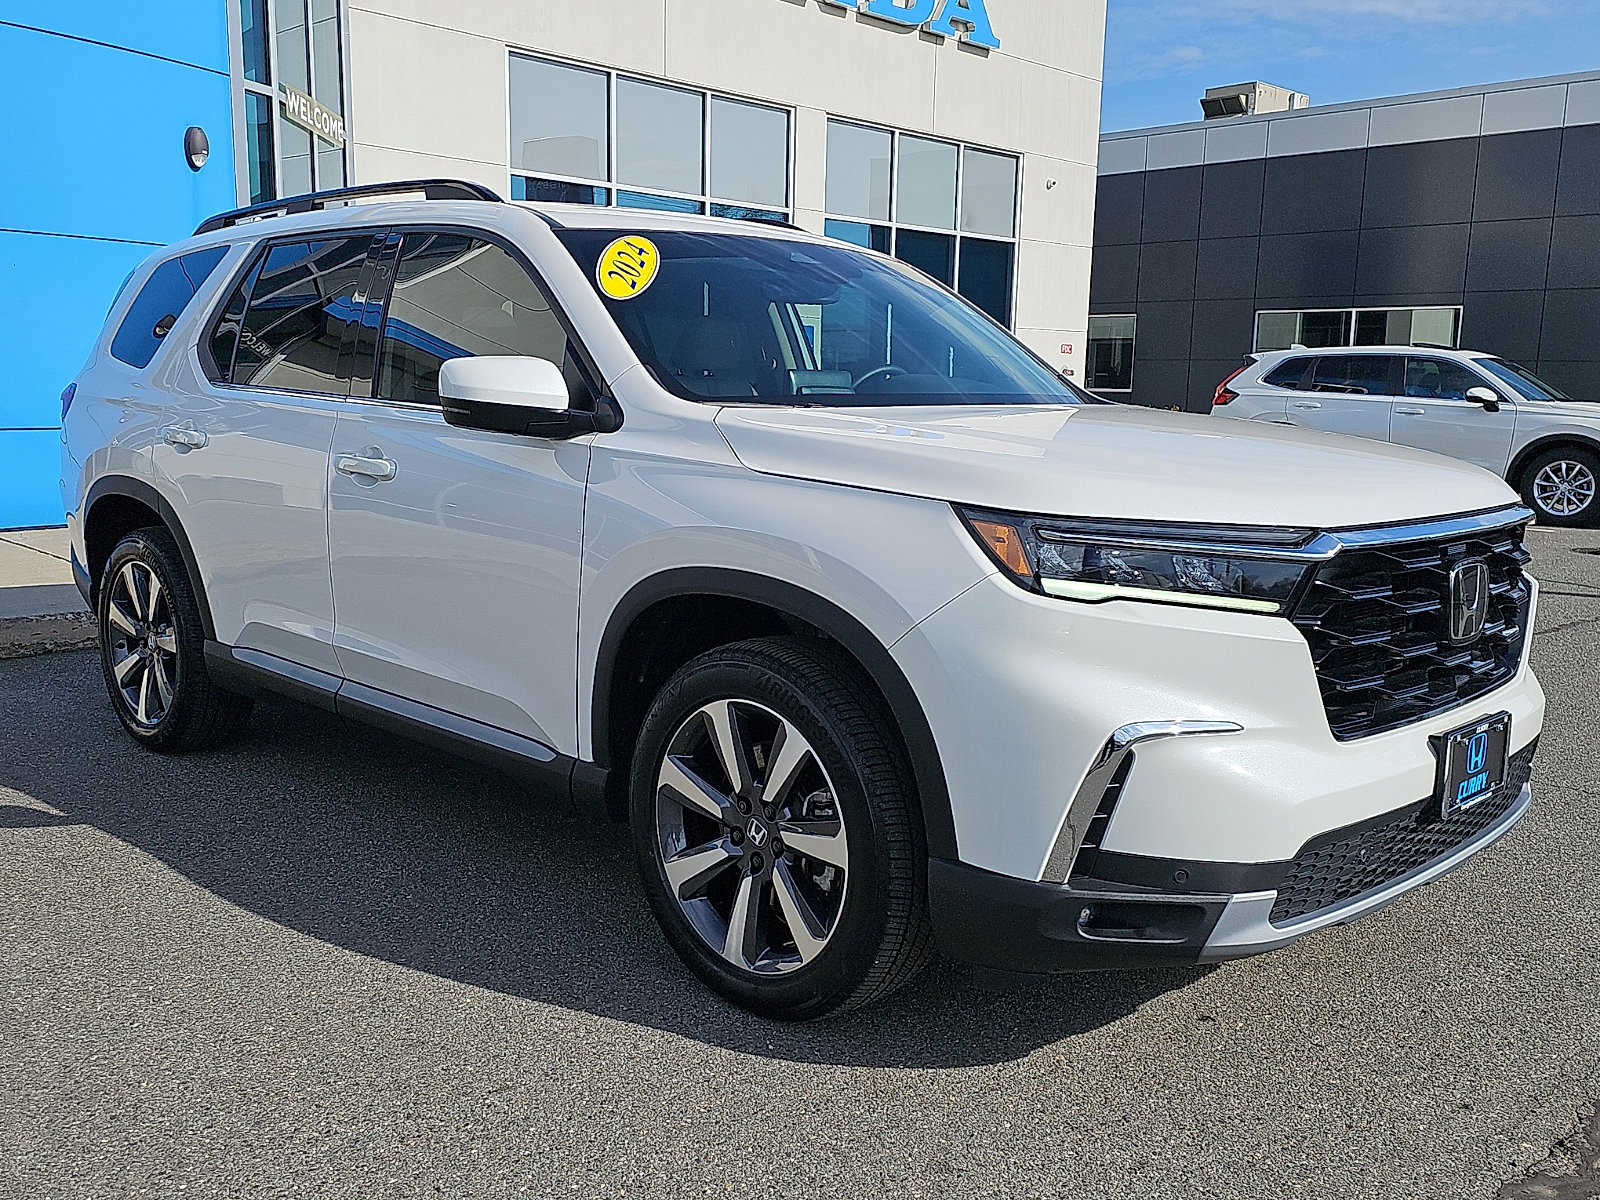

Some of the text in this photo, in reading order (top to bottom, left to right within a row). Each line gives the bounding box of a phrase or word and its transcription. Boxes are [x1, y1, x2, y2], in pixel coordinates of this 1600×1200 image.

[286, 88, 344, 144] WELCOME
[608, 240, 649, 290] 2024
[1457, 770, 1489, 800] CURRY
